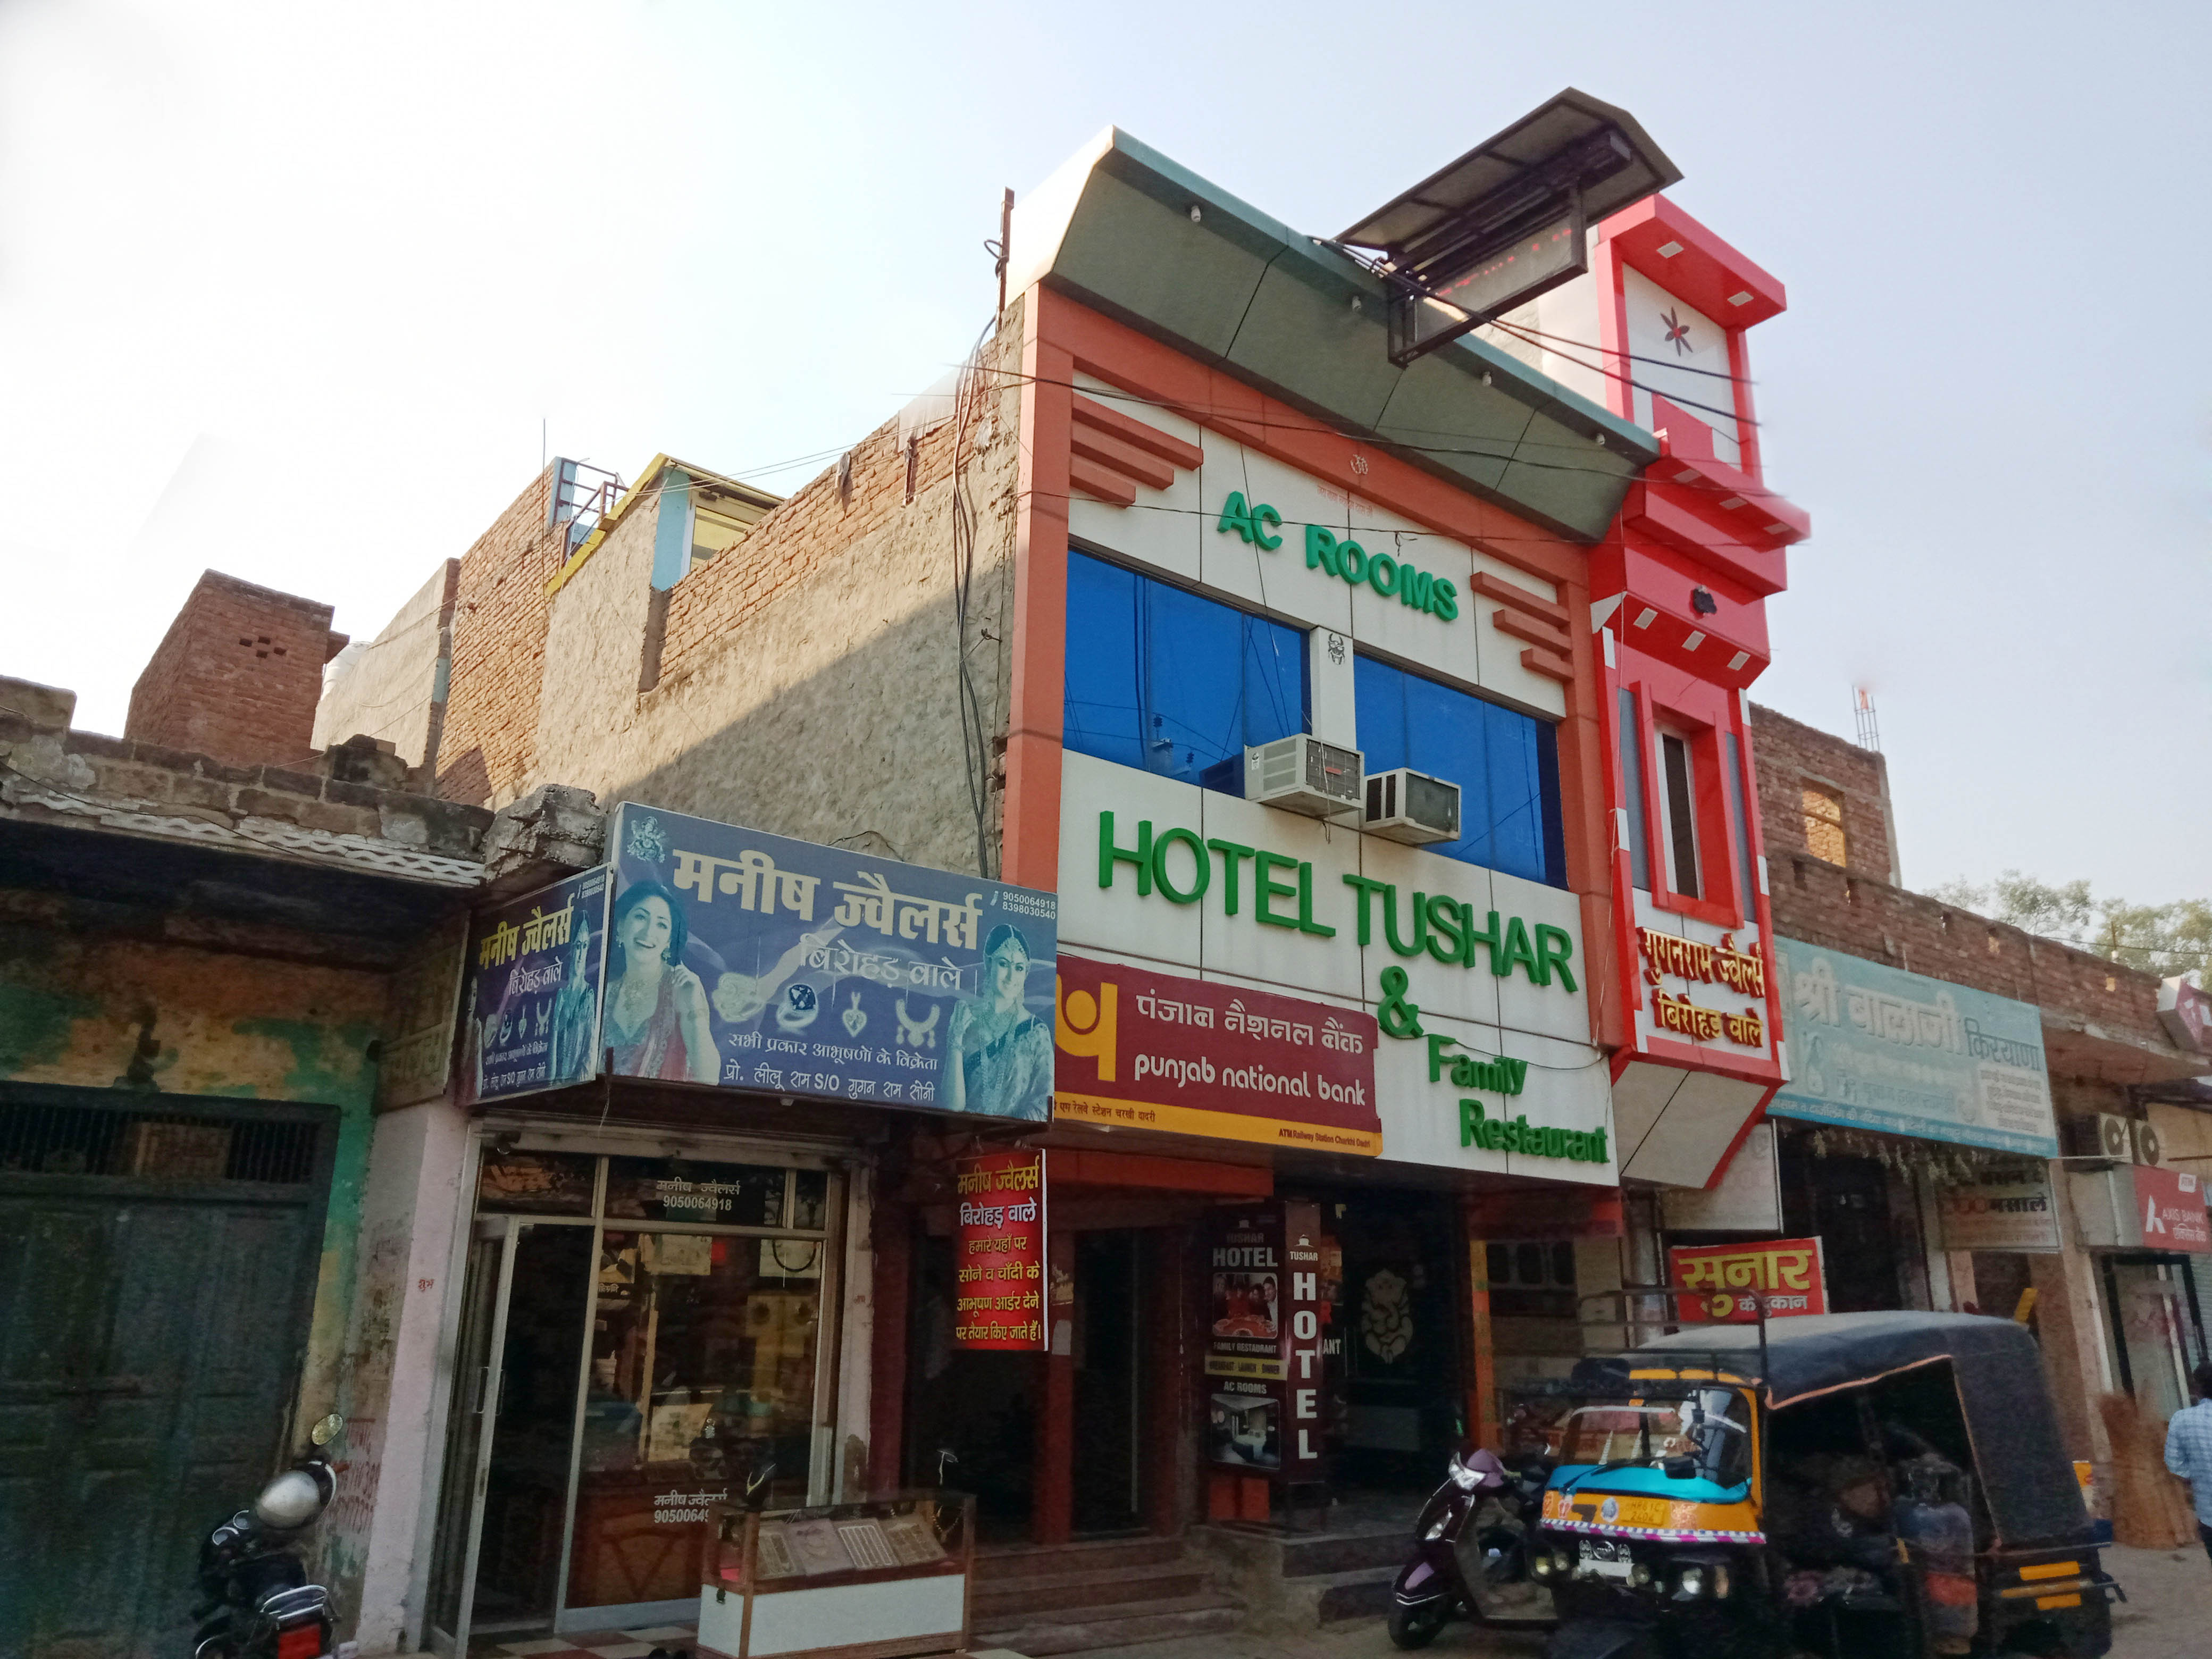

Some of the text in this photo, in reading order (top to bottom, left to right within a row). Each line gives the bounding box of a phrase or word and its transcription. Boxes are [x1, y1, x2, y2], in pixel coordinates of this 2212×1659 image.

[1217, 491, 1459, 622] AC ROOMS
[672, 849, 983, 950] मनीष ज्वैलर्स
[1002, 891, 1056, 910] 9050064918
[1002, 901, 1056, 920] 8398030540
[1099, 810, 1578, 992] HOTEL TUSHAR
[479, 892, 575, 970] मनीष ज्वैलर्स
[543, 956, 563, 985] वाले
[908, 956, 963, 990] वाले
[1378, 966, 1424, 1038] &
[1136, 988, 1363, 1055] पंजाब नैशनल बैंक
[729, 1031, 763, 1049] सभी
[765, 1037, 807, 1055] प्रकार
[876, 1048, 891, 1065] के
[895, 1050, 937, 1070] विक्रेता
[1428, 1034, 1528, 1095] Family
[754, 1062, 785, 1092] लीलू
[791, 1070, 811, 1088] राम
[814, 1073, 840, 1091] S/O
[883, 1080, 902, 1098] राम
[910, 1079, 935, 1101] सोनी
[1135, 1053, 1365, 1107] punjab national bank
[1073, 1100, 1088, 1115] रेलवे
[1092, 1103, 1112, 1117] स्टेशन
[1279, 1128, 1292, 1138] ATM
[1293, 1130, 1314, 1142] Railway
[1315, 1133, 1334, 1143] Station
[1459, 1098, 1610, 1163] Restaurant
[656, 1176, 741, 1195] मनीष ज्वैलर्स
[958, 1155, 1040, 1195] मनीष ज्वैलर्स
[663, 1195, 732, 1211] 9050064918
[1008, 1196, 1037, 1222] वाले
[969, 1233, 1027, 1255] हमारे यहाँ पर
[1212, 1247, 1278, 1267] HOTEL
[1289, 1250, 1319, 1262] TUSHAR
[959, 1260, 1041, 1283] सोने व चाँदी के
[1678, 1250, 1813, 1318] सुनार
[957, 1290, 1040, 1318] आभूषण आर्डर देने
[956, 1327, 967, 1340] पर
[968, 1321, 988, 1340] तैयार
[990, 1320, 1007, 1340] किए
[1009, 1321, 1028, 1340] जाते
[1213, 1341, 1277, 1354] FAMILY RESTAURANT
[1323, 1338, 1342, 1355] ANT
[1293, 1271, 1318, 1460] HOTEL
[1224, 1381, 1267, 1394] AC ROOMS
[654, 1489, 687, 1506] मनीष
